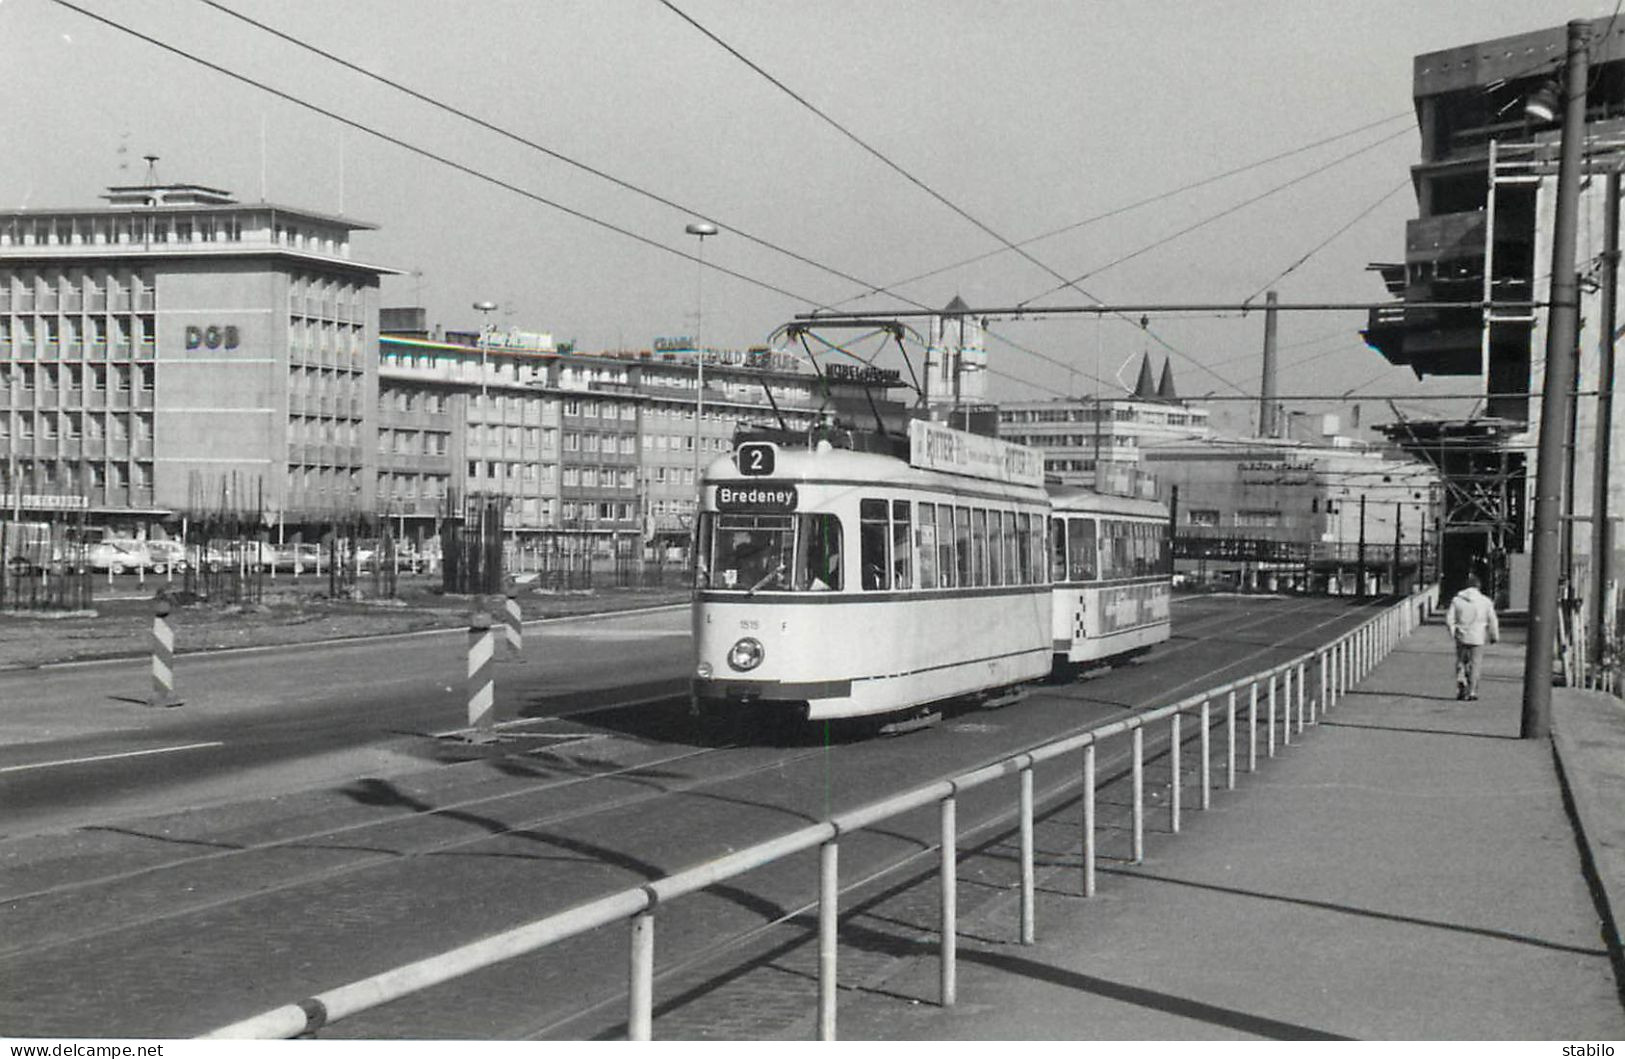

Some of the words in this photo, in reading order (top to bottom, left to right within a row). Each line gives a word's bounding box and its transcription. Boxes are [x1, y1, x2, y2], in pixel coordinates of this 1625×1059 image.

[185, 325, 241, 350] DGB
[750, 449, 763, 470] 2
[720, 487, 793, 506] Bredeney
